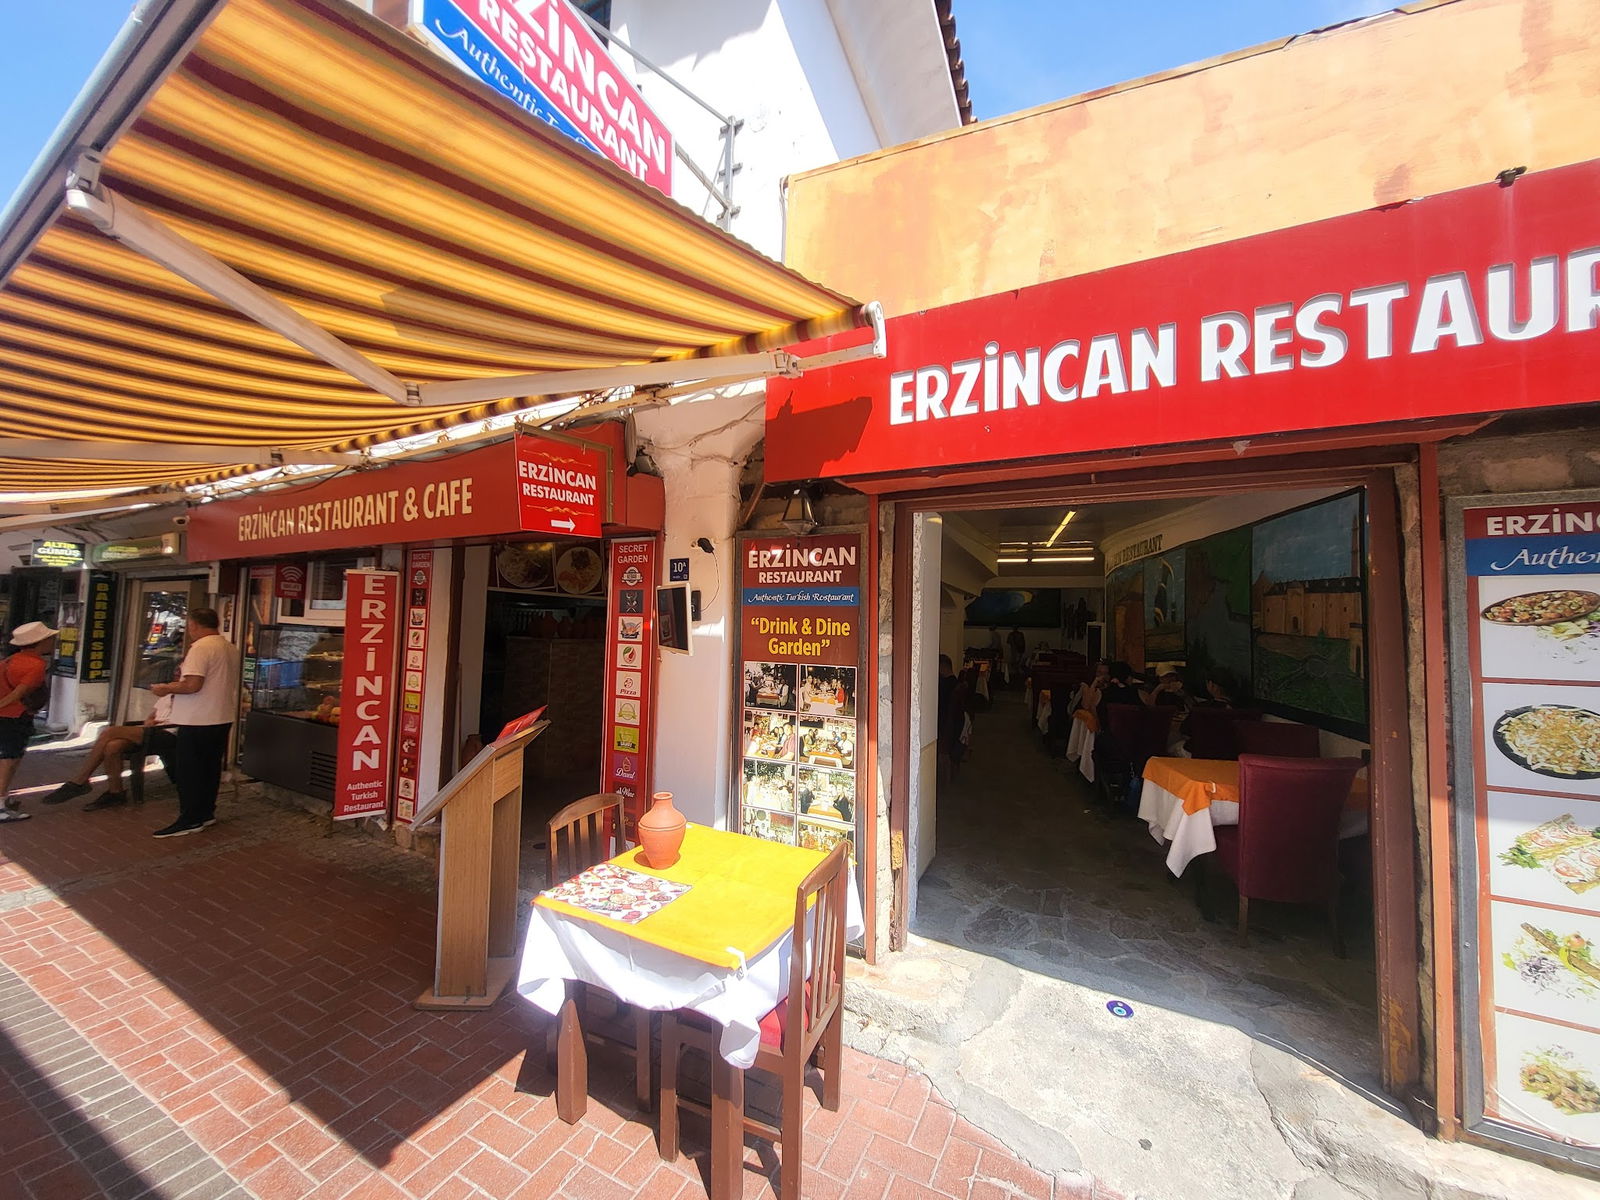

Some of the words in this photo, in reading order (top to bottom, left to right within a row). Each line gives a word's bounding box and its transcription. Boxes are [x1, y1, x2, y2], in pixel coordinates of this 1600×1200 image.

[434, 19, 543, 116] Authentic
[890, 329, 1176, 425] ERZİNCAN
[518, 460, 597, 490] ERZİNCAN
[522, 482, 594, 506] RESTAURANT
[238, 505, 295, 542] ERZİNCAN
[298, 490, 399, 534] RESTAURANT
[403, 487, 418, 521] &
[423, 478, 473, 519] CAFE
[619, 544, 648, 553] SECRET
[748, 544, 856, 568] ERZİNCAN
[617, 555, 648, 563] GARDEN
[758, 570, 842, 583] RESTAURANT
[748, 593, 783, 603] Authentic
[785, 591, 811, 601] Turkish
[812, 593, 854, 602] Restaurant
[801, 618, 812, 635] &
[816, 618, 851, 636] Dine
[88, 641, 105, 679] SHOP
[620, 688, 637, 696] Pizza
[346, 780, 383, 791] Authentic
[352, 791, 378, 800] Turkish
[343, 801, 384, 812] Restaurant
